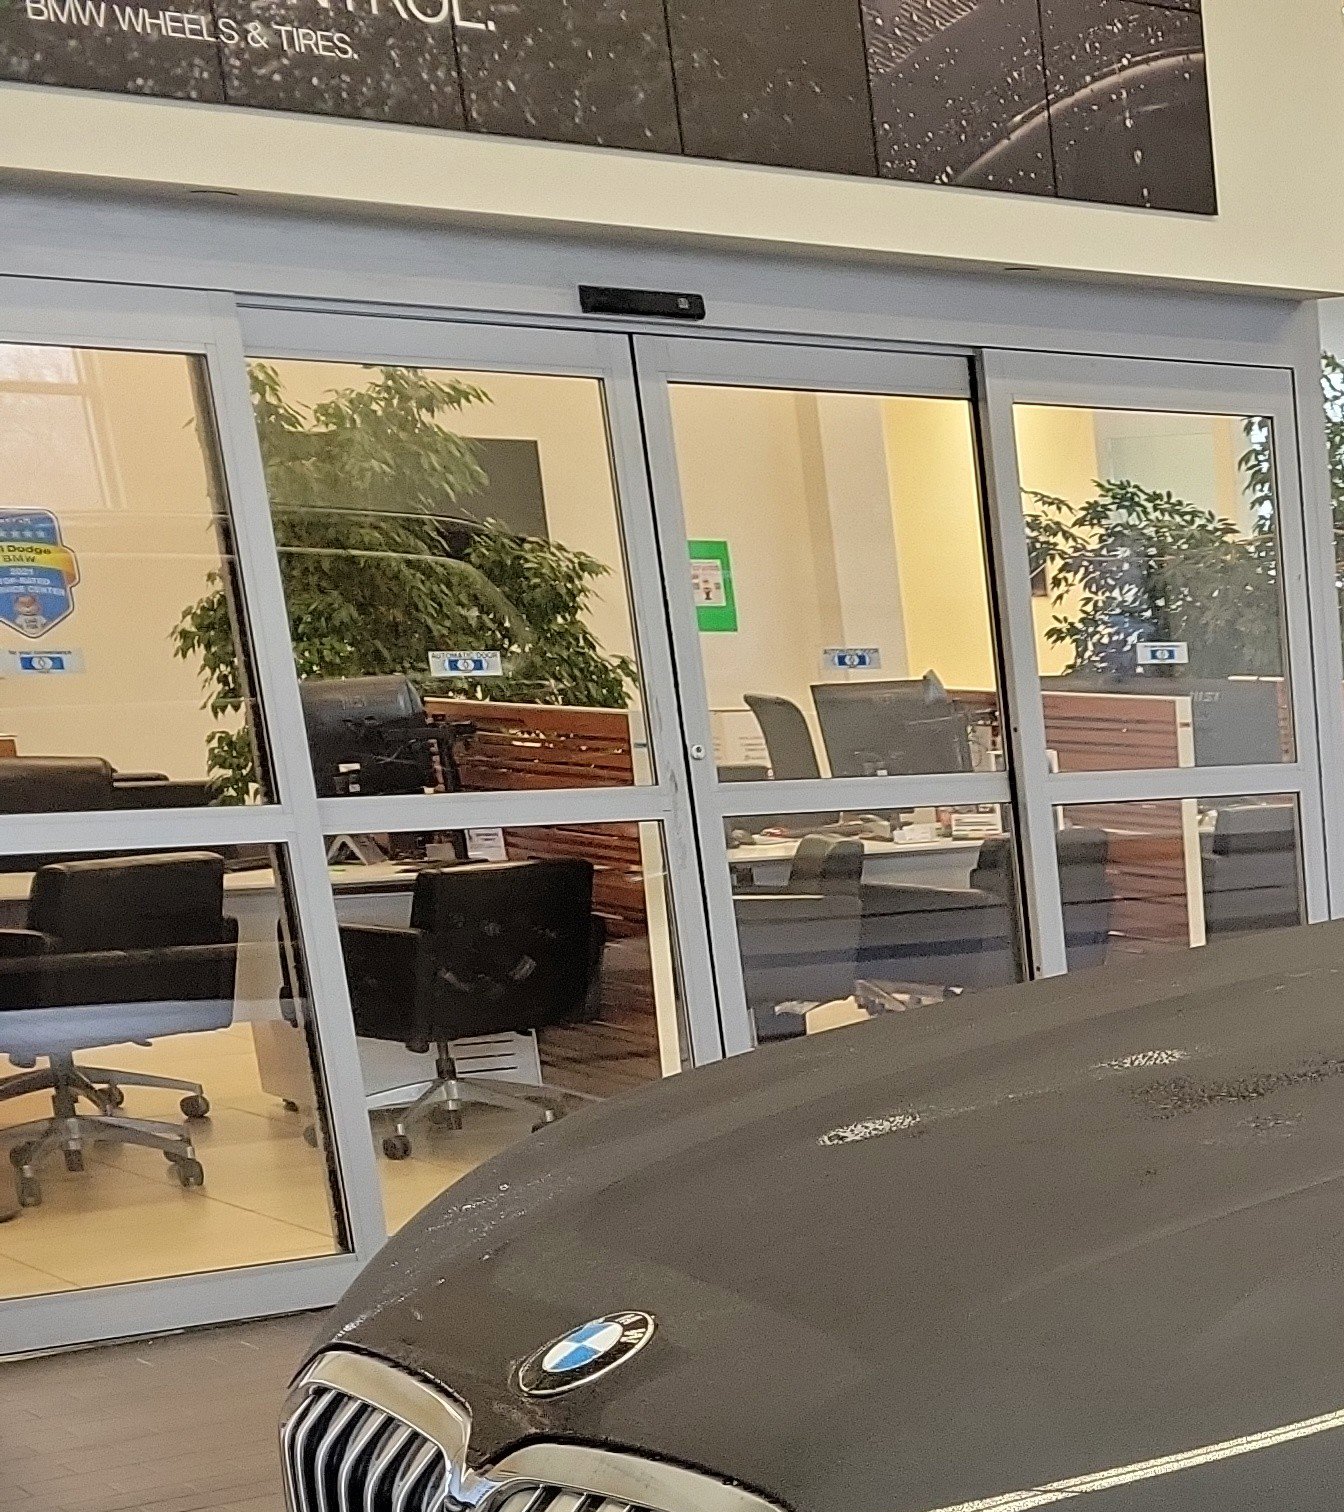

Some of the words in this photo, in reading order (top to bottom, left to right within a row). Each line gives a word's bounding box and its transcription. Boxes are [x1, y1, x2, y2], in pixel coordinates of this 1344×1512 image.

[25, 0, 104, 28] BMW
[115, 3, 240, 44] WHEELS
[246, 21, 270, 49] &
[273, 25, 360, 60] TIRES.
[7, 544, 52, 555] Dodge
[3, 554, 36, 563] BMW
